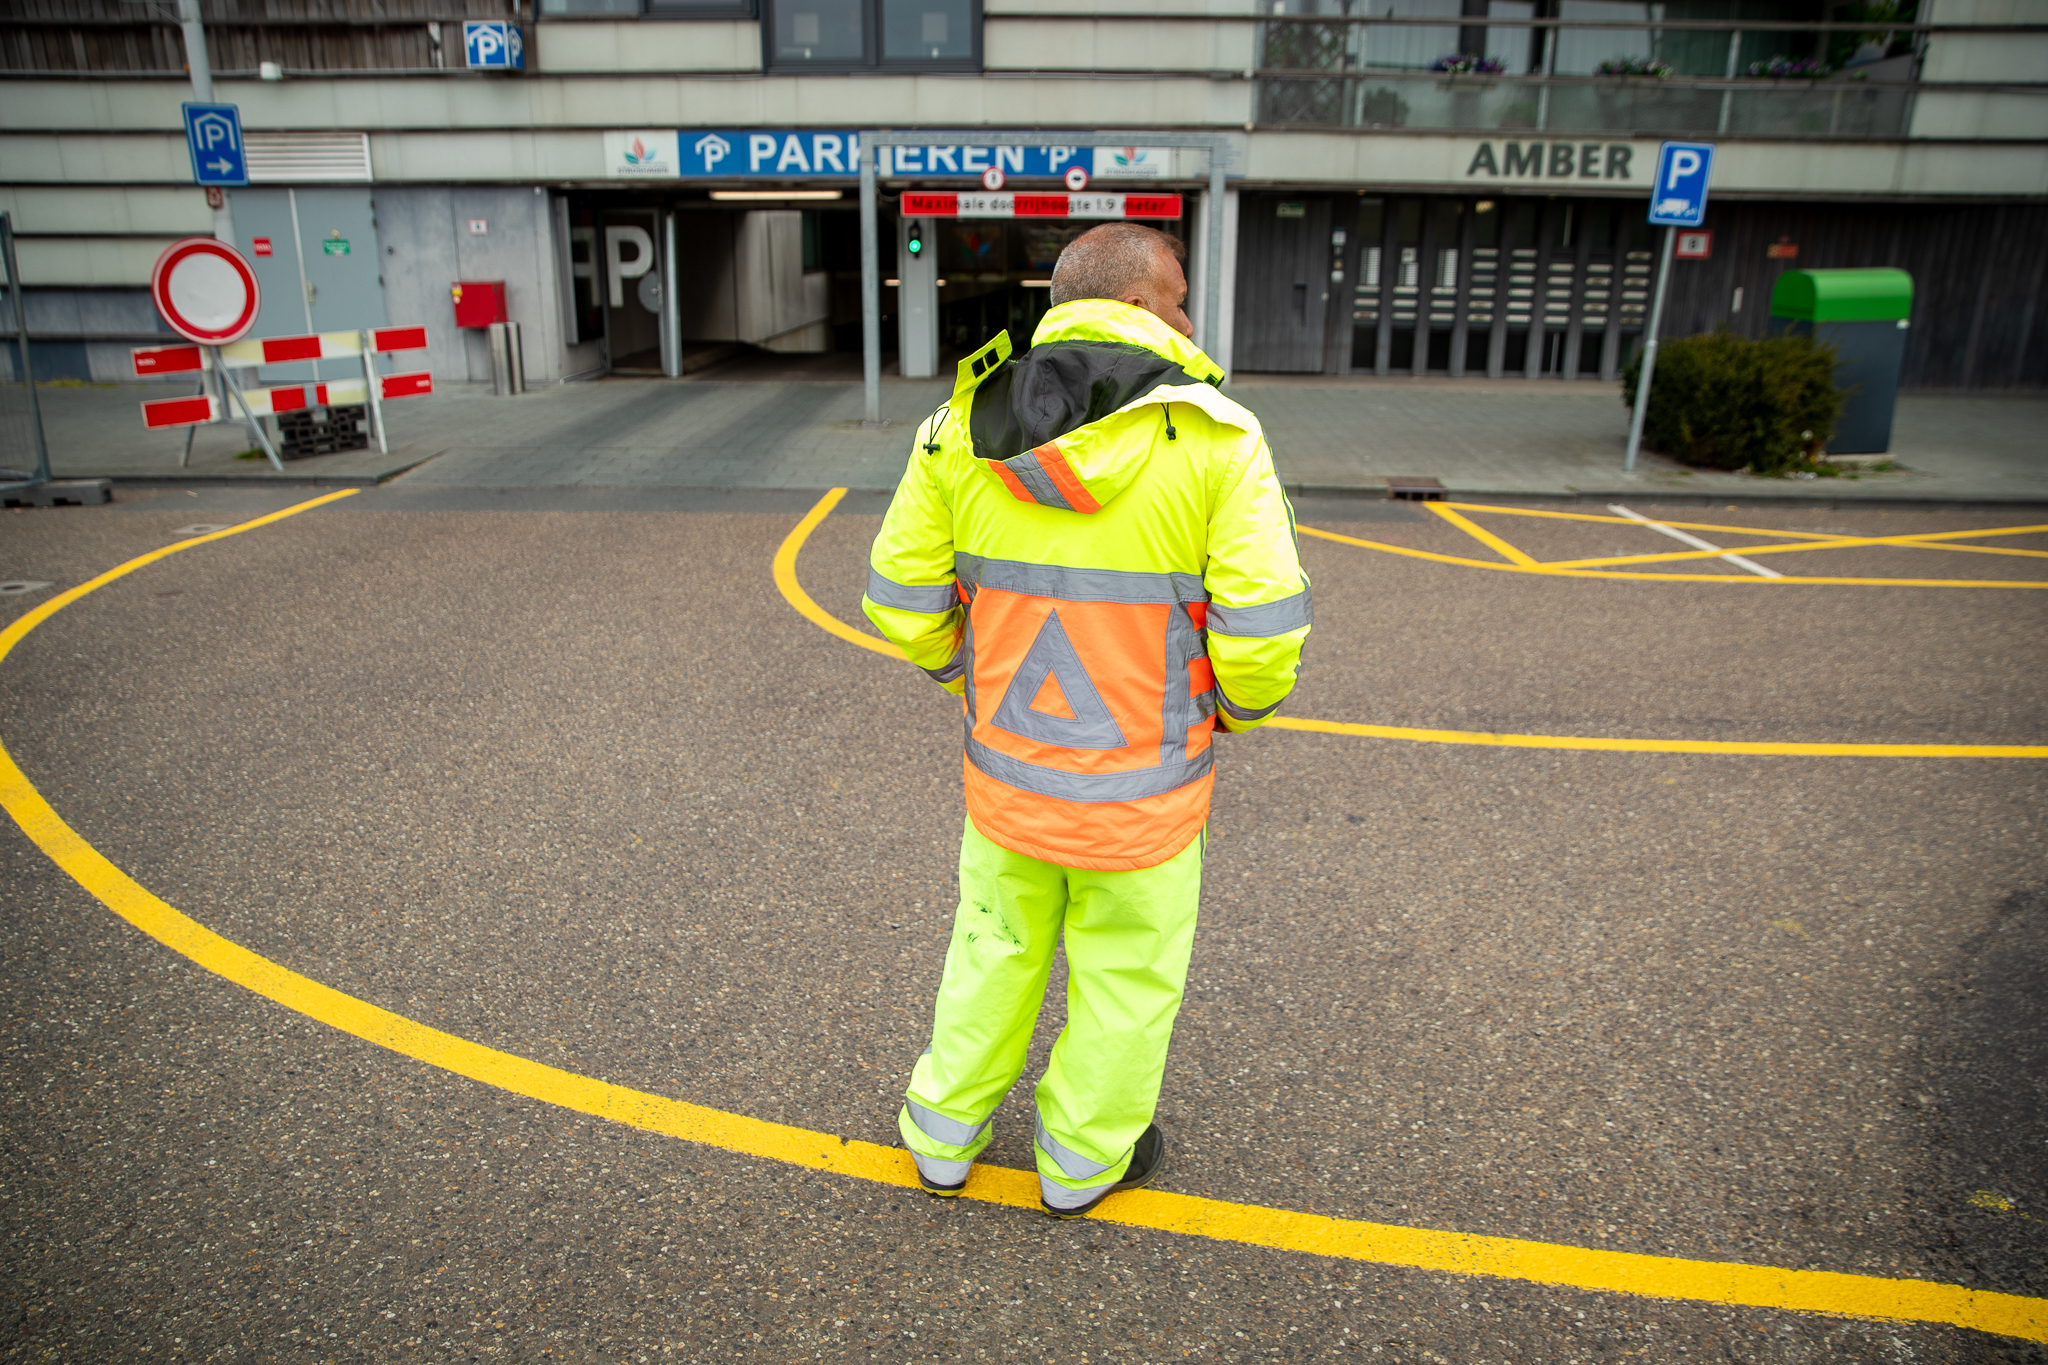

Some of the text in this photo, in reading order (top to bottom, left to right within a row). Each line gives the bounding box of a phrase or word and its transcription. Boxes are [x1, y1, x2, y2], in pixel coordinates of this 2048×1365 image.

[205, 123, 225, 150] P
[1466, 141, 1632, 179] AMBER
[1667, 149, 1700, 190] P
[911, 197, 985, 211] Maximale
[990, 197, 1090, 214] doorrijhoogte
[1121, 200, 1167, 212] meter
[605, 225, 653, 307] P
